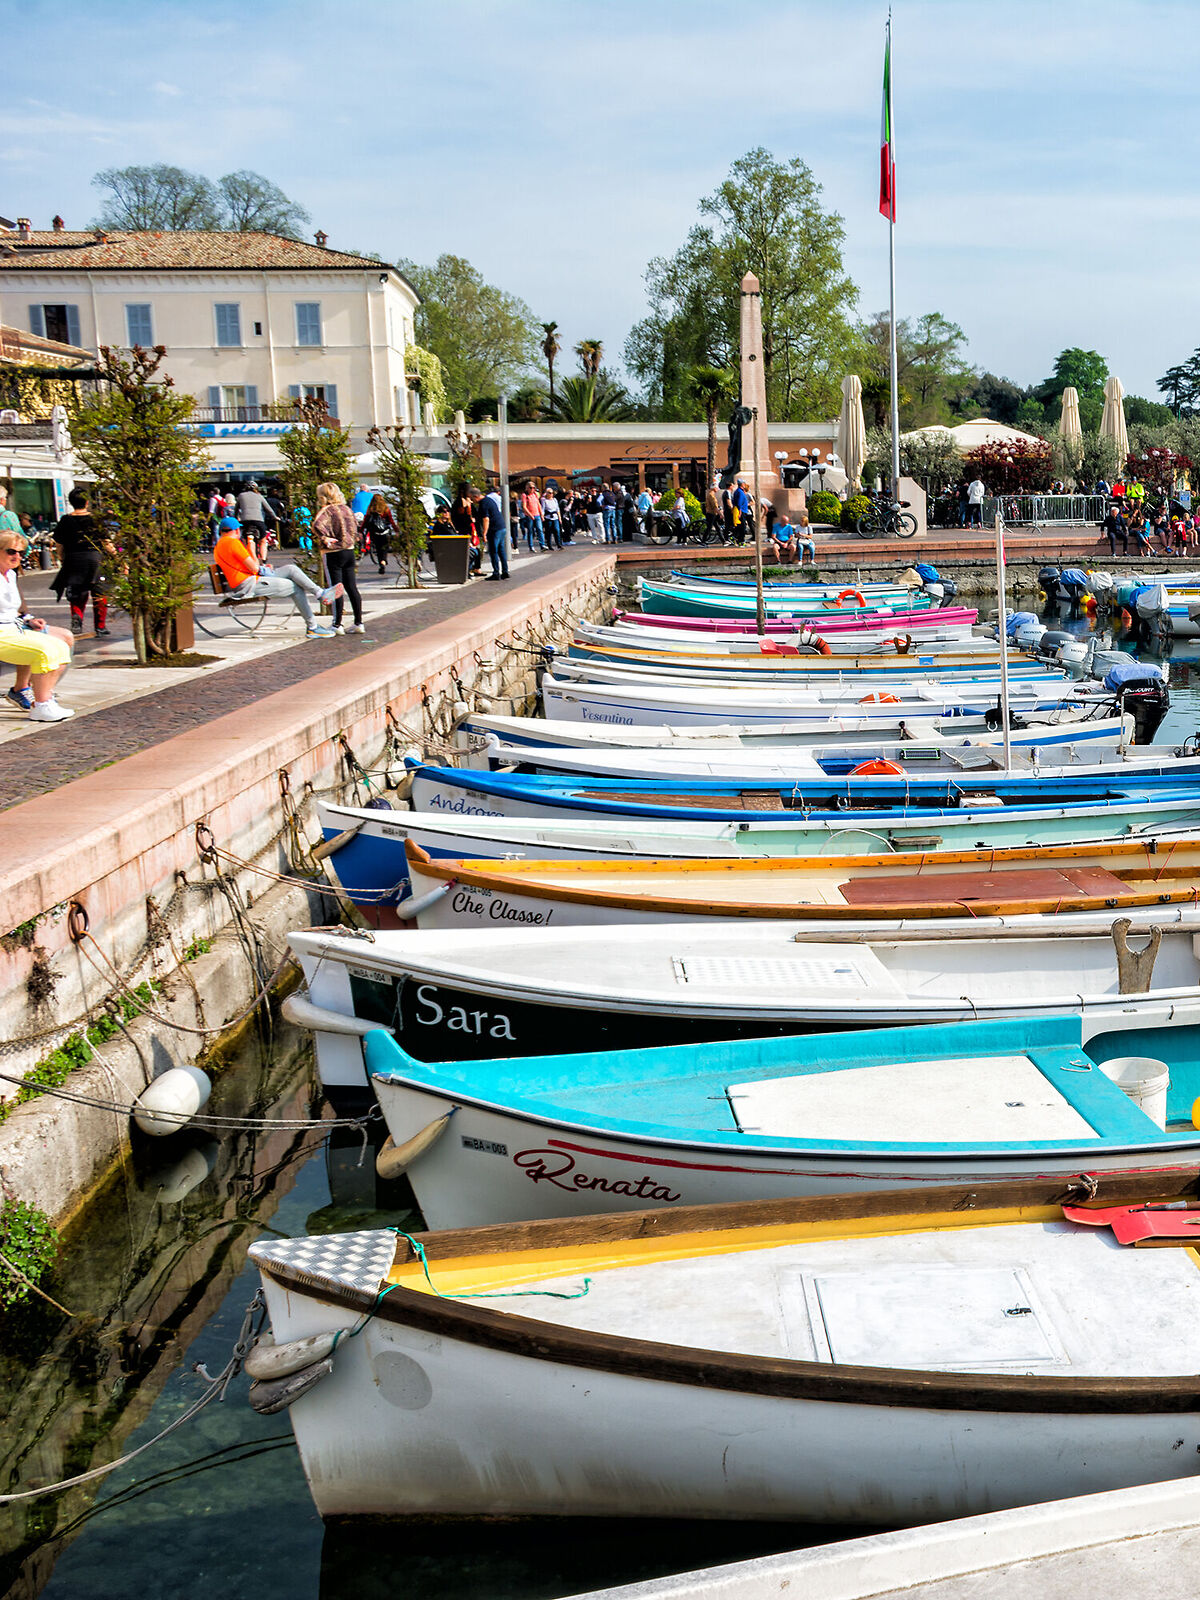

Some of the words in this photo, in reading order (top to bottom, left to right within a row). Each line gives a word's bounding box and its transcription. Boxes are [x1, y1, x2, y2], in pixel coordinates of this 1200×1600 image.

[220, 424, 293, 437] gelateri
[582, 707, 633, 726] Vesentina
[452, 892, 485, 915] Che
[415, 984, 518, 1041] Sara
[512, 1148, 681, 1202] Renata
